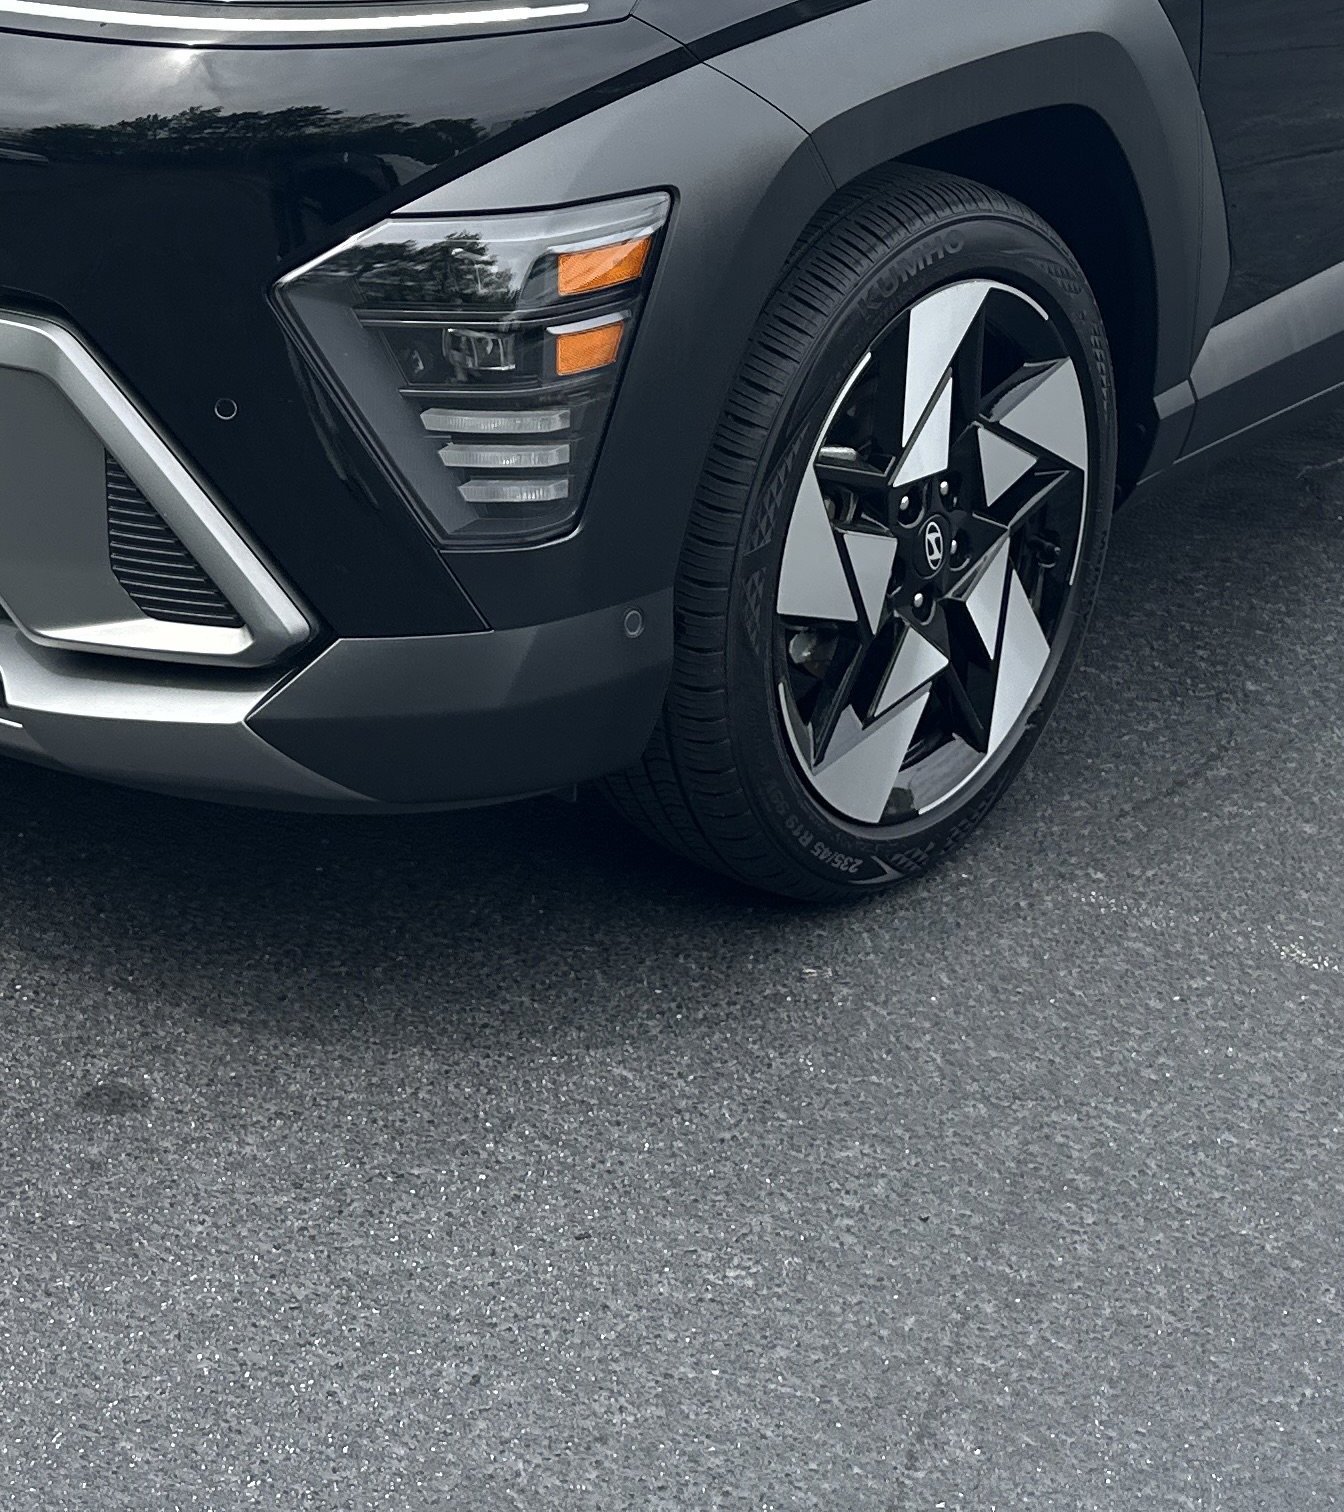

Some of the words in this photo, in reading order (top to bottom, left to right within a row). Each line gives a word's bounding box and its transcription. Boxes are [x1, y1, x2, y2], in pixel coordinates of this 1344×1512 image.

[857, 229, 966, 322] KUMHO
[785, 814, 814, 848] R19
[809, 840, 864, 874] 235/45
